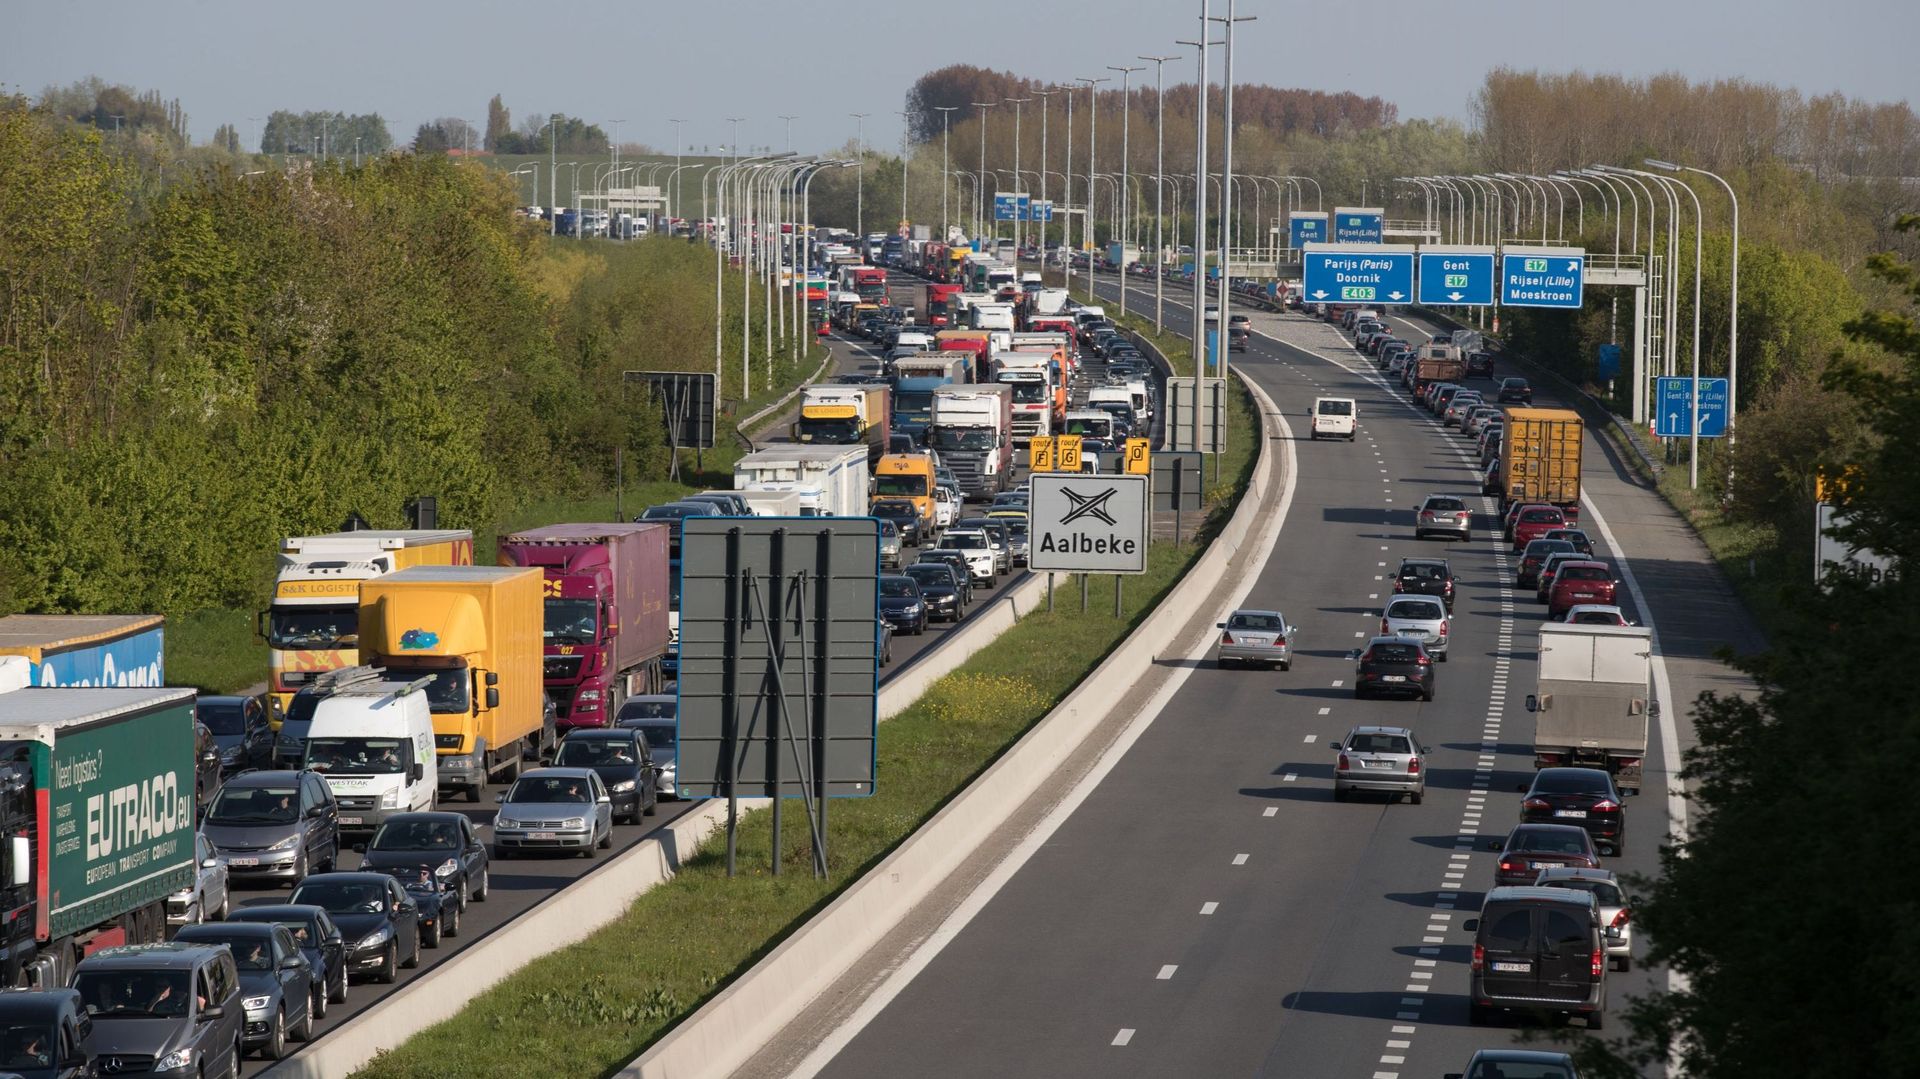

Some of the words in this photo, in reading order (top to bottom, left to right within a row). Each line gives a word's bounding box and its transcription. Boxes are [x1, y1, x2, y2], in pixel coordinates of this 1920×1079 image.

[1339, 229, 1358, 237] Rijsel
[1324, 258, 1358, 270] Parijs
[1360, 259, 1393, 271] (Paris)
[1443, 260, 1470, 271] Gent
[1527, 260, 1546, 271] E17
[1336, 273, 1381, 283] Doornik
[1446, 276, 1466, 286] E17
[1510, 275, 1542, 287] Rijsel
[1545, 276, 1575, 288] (Lille)
[1343, 288, 1374, 299] E403
[1511, 289, 1572, 300] Moeskroen
[1668, 381, 1680, 389] E17
[1700, 382, 1711, 390] E17
[1667, 391, 1681, 399] Gent
[1685, 392, 1703, 400] Riel
[1705, 392, 1725, 402] (Lille)
[1687, 401, 1722, 409] Meskroen
[1038, 453, 1045, 464] F
[1065, 452, 1074, 463] G
[1512, 462, 1526, 473] 45
[1040, 532, 1135, 554] Aalbeke
[282, 584, 307, 594] S&K
[55, 756, 72, 790] Need
[73, 752, 97, 792] logistics
[86, 771, 190, 862] EUTRACO.eu
[86, 861, 116, 885] EUROPEAN
[119, 848, 150, 873] TRANSPORT
[152, 839, 178, 860] COMPANY
